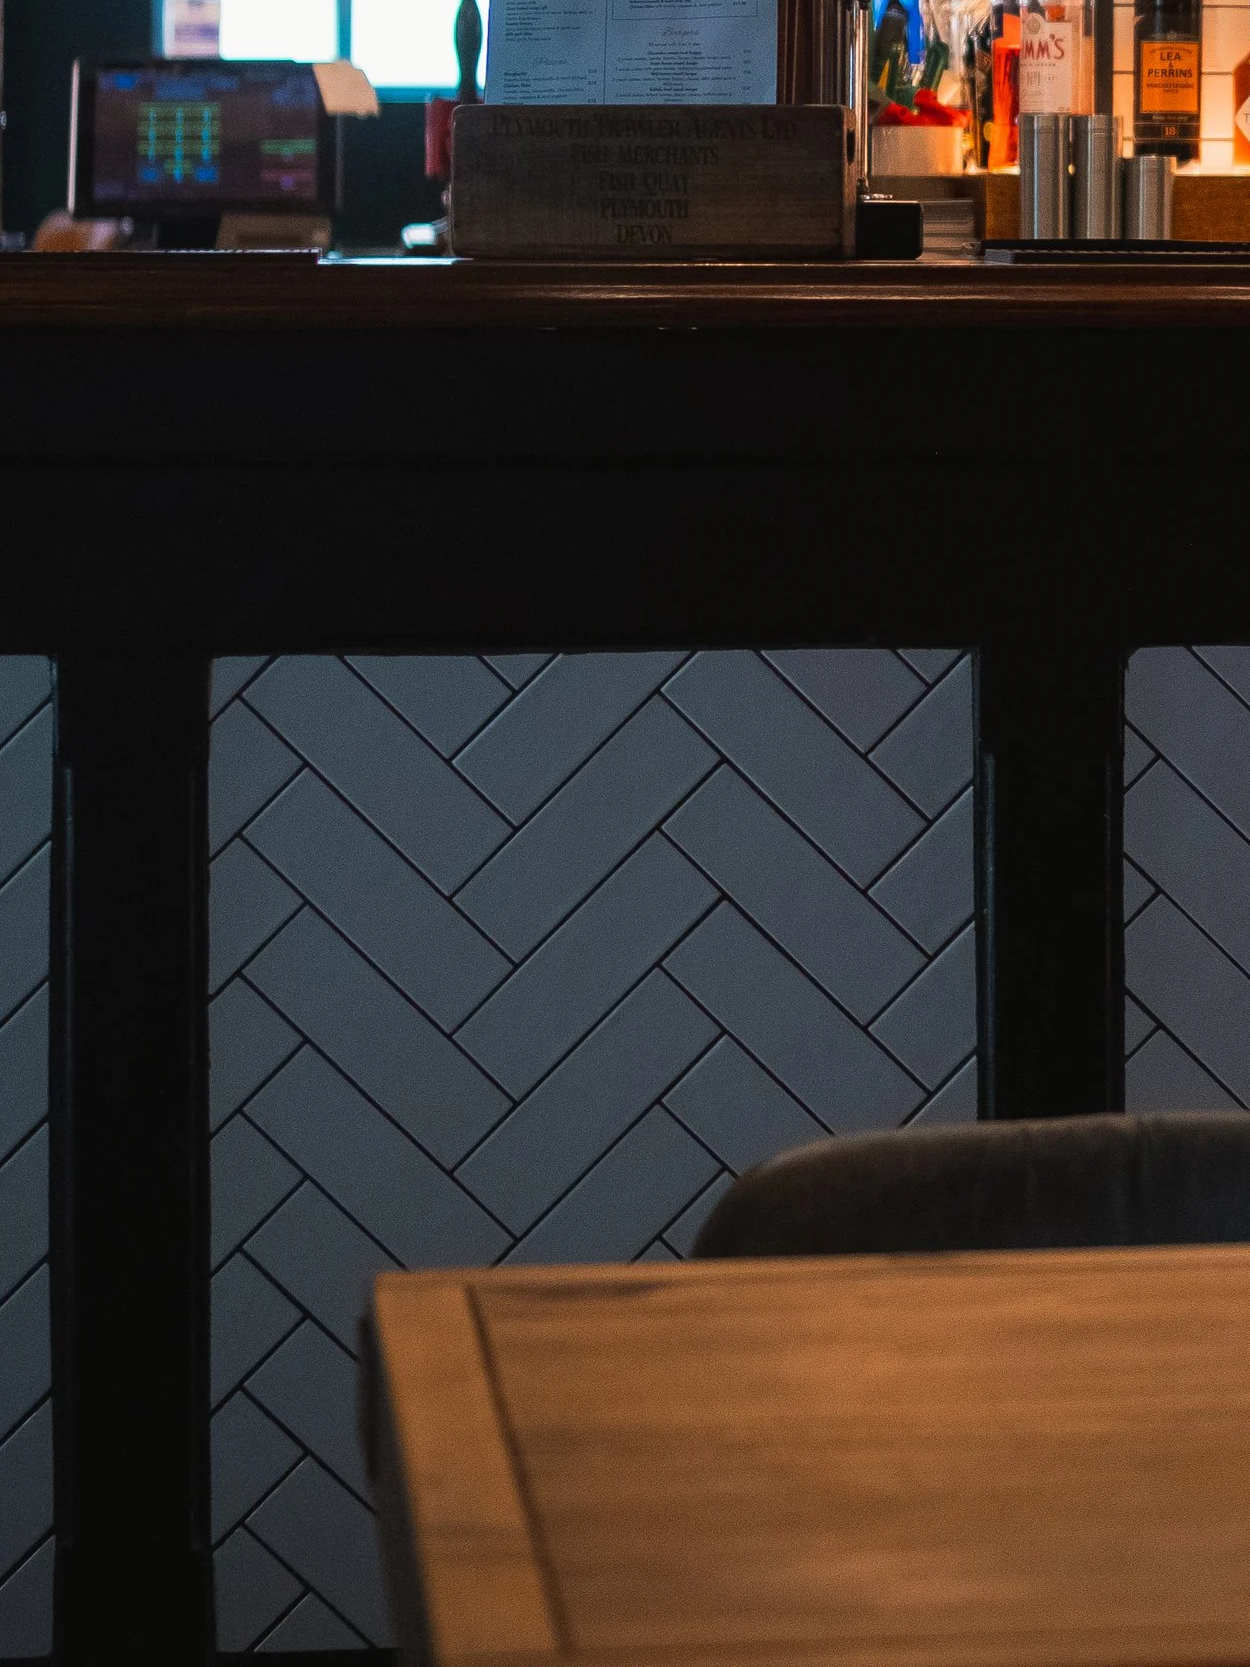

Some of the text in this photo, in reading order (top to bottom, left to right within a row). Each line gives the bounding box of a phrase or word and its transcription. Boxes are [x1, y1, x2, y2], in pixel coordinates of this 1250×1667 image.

[1160, 51, 1182, 62] LEA
[1147, 68, 1194, 79] PERRINS
[599, 198, 689, 219] PLYMOUTH
[615, 223, 674, 245] DEVON
